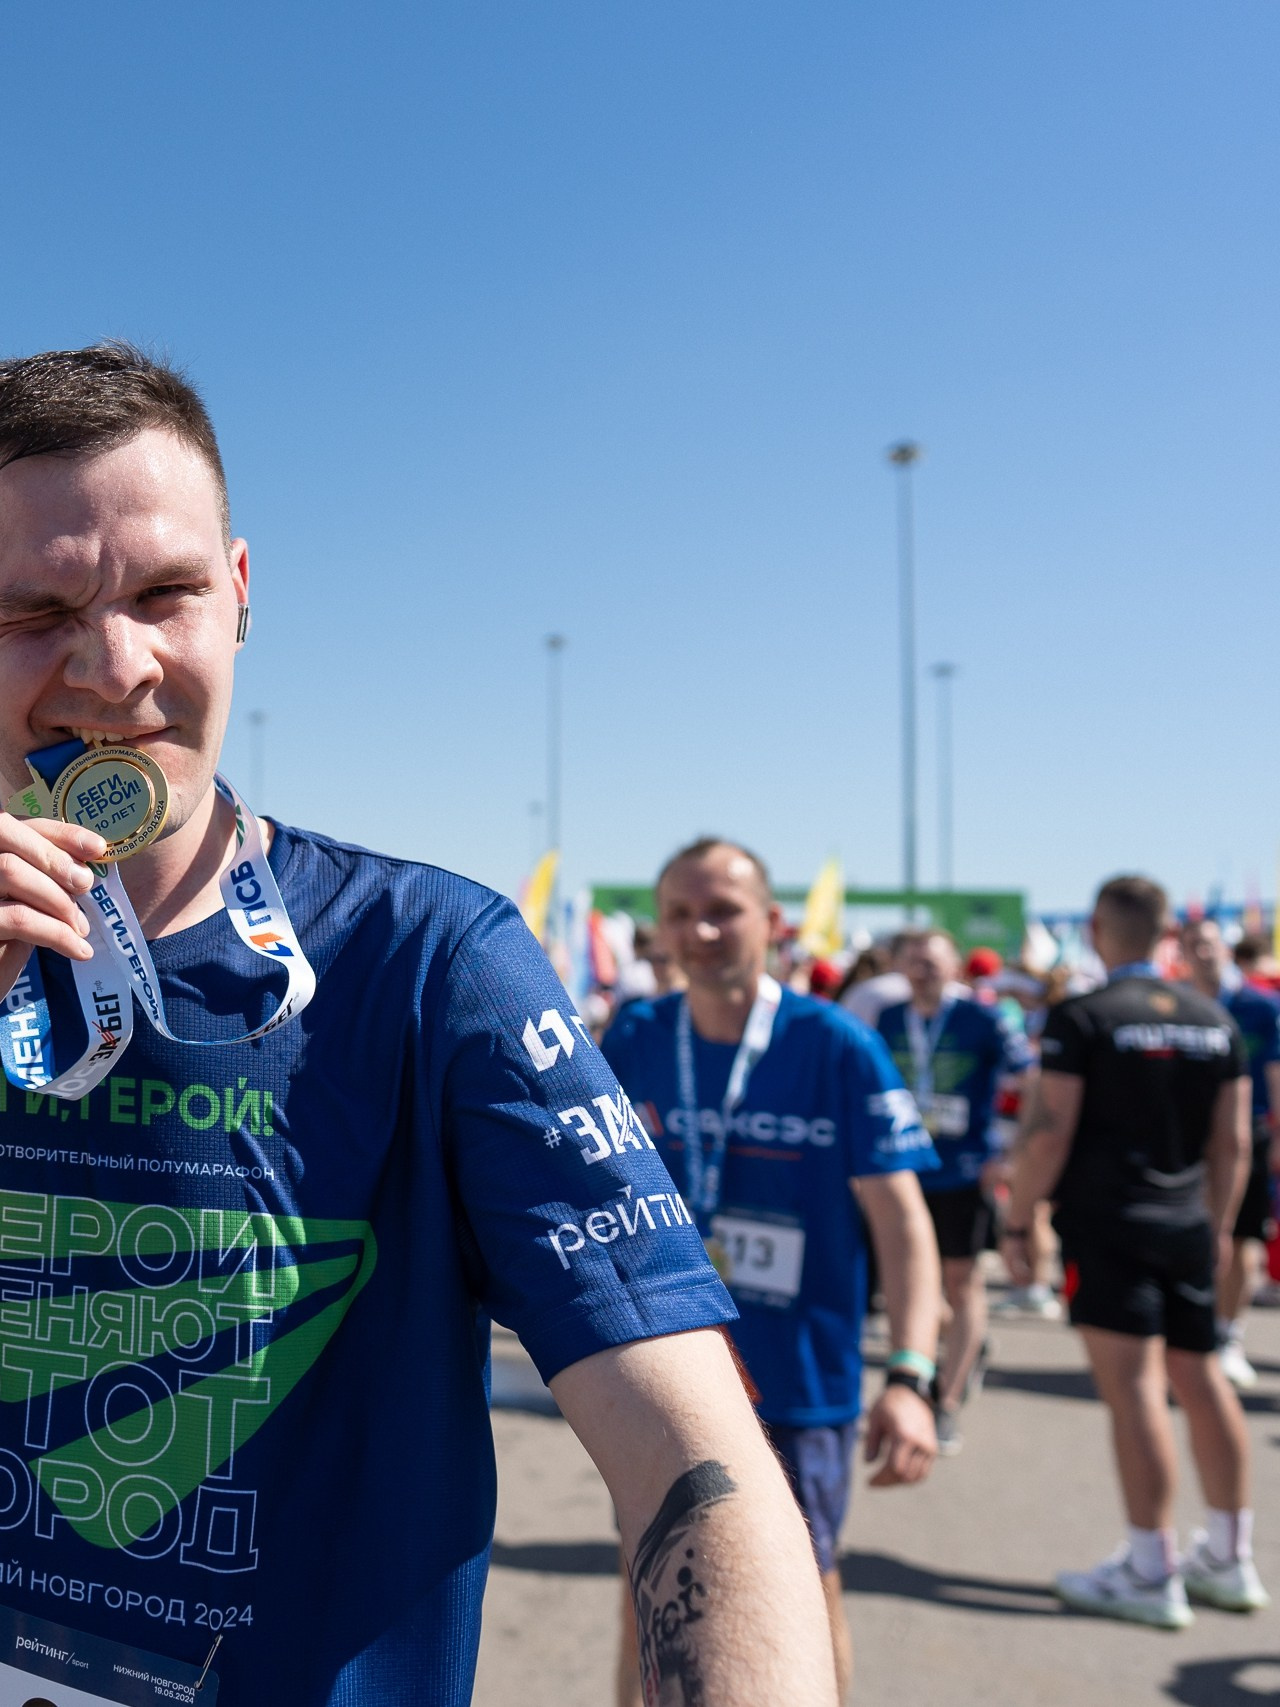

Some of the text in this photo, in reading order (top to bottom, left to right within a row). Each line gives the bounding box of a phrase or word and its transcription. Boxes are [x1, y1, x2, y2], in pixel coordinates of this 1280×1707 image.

[52, 749, 151, 818] БЛАГОТВОРИТЕЛЬНЫЙ ПОЛУМАРАФОН
[74, 779, 142, 826] ГЕРОЙ!
[76, 773, 128, 809] БЕГИ,
[95, 802, 137, 832] 10 ЛЕТ
[116, 799, 166, 856] НОВГОРОД 2024
[230, 860, 271, 928] ПСБ
[137, 1157, 275, 1181] ПОЛУМАРАФОН
[30, 1569, 186, 1627] НОВГОРОД
[194, 1602, 254, 1632] 2024
[113, 1664, 196, 1696] НИЖНИЙ НОВГОРОД
[153, 1686, 194, 1704] 19.05.2024
